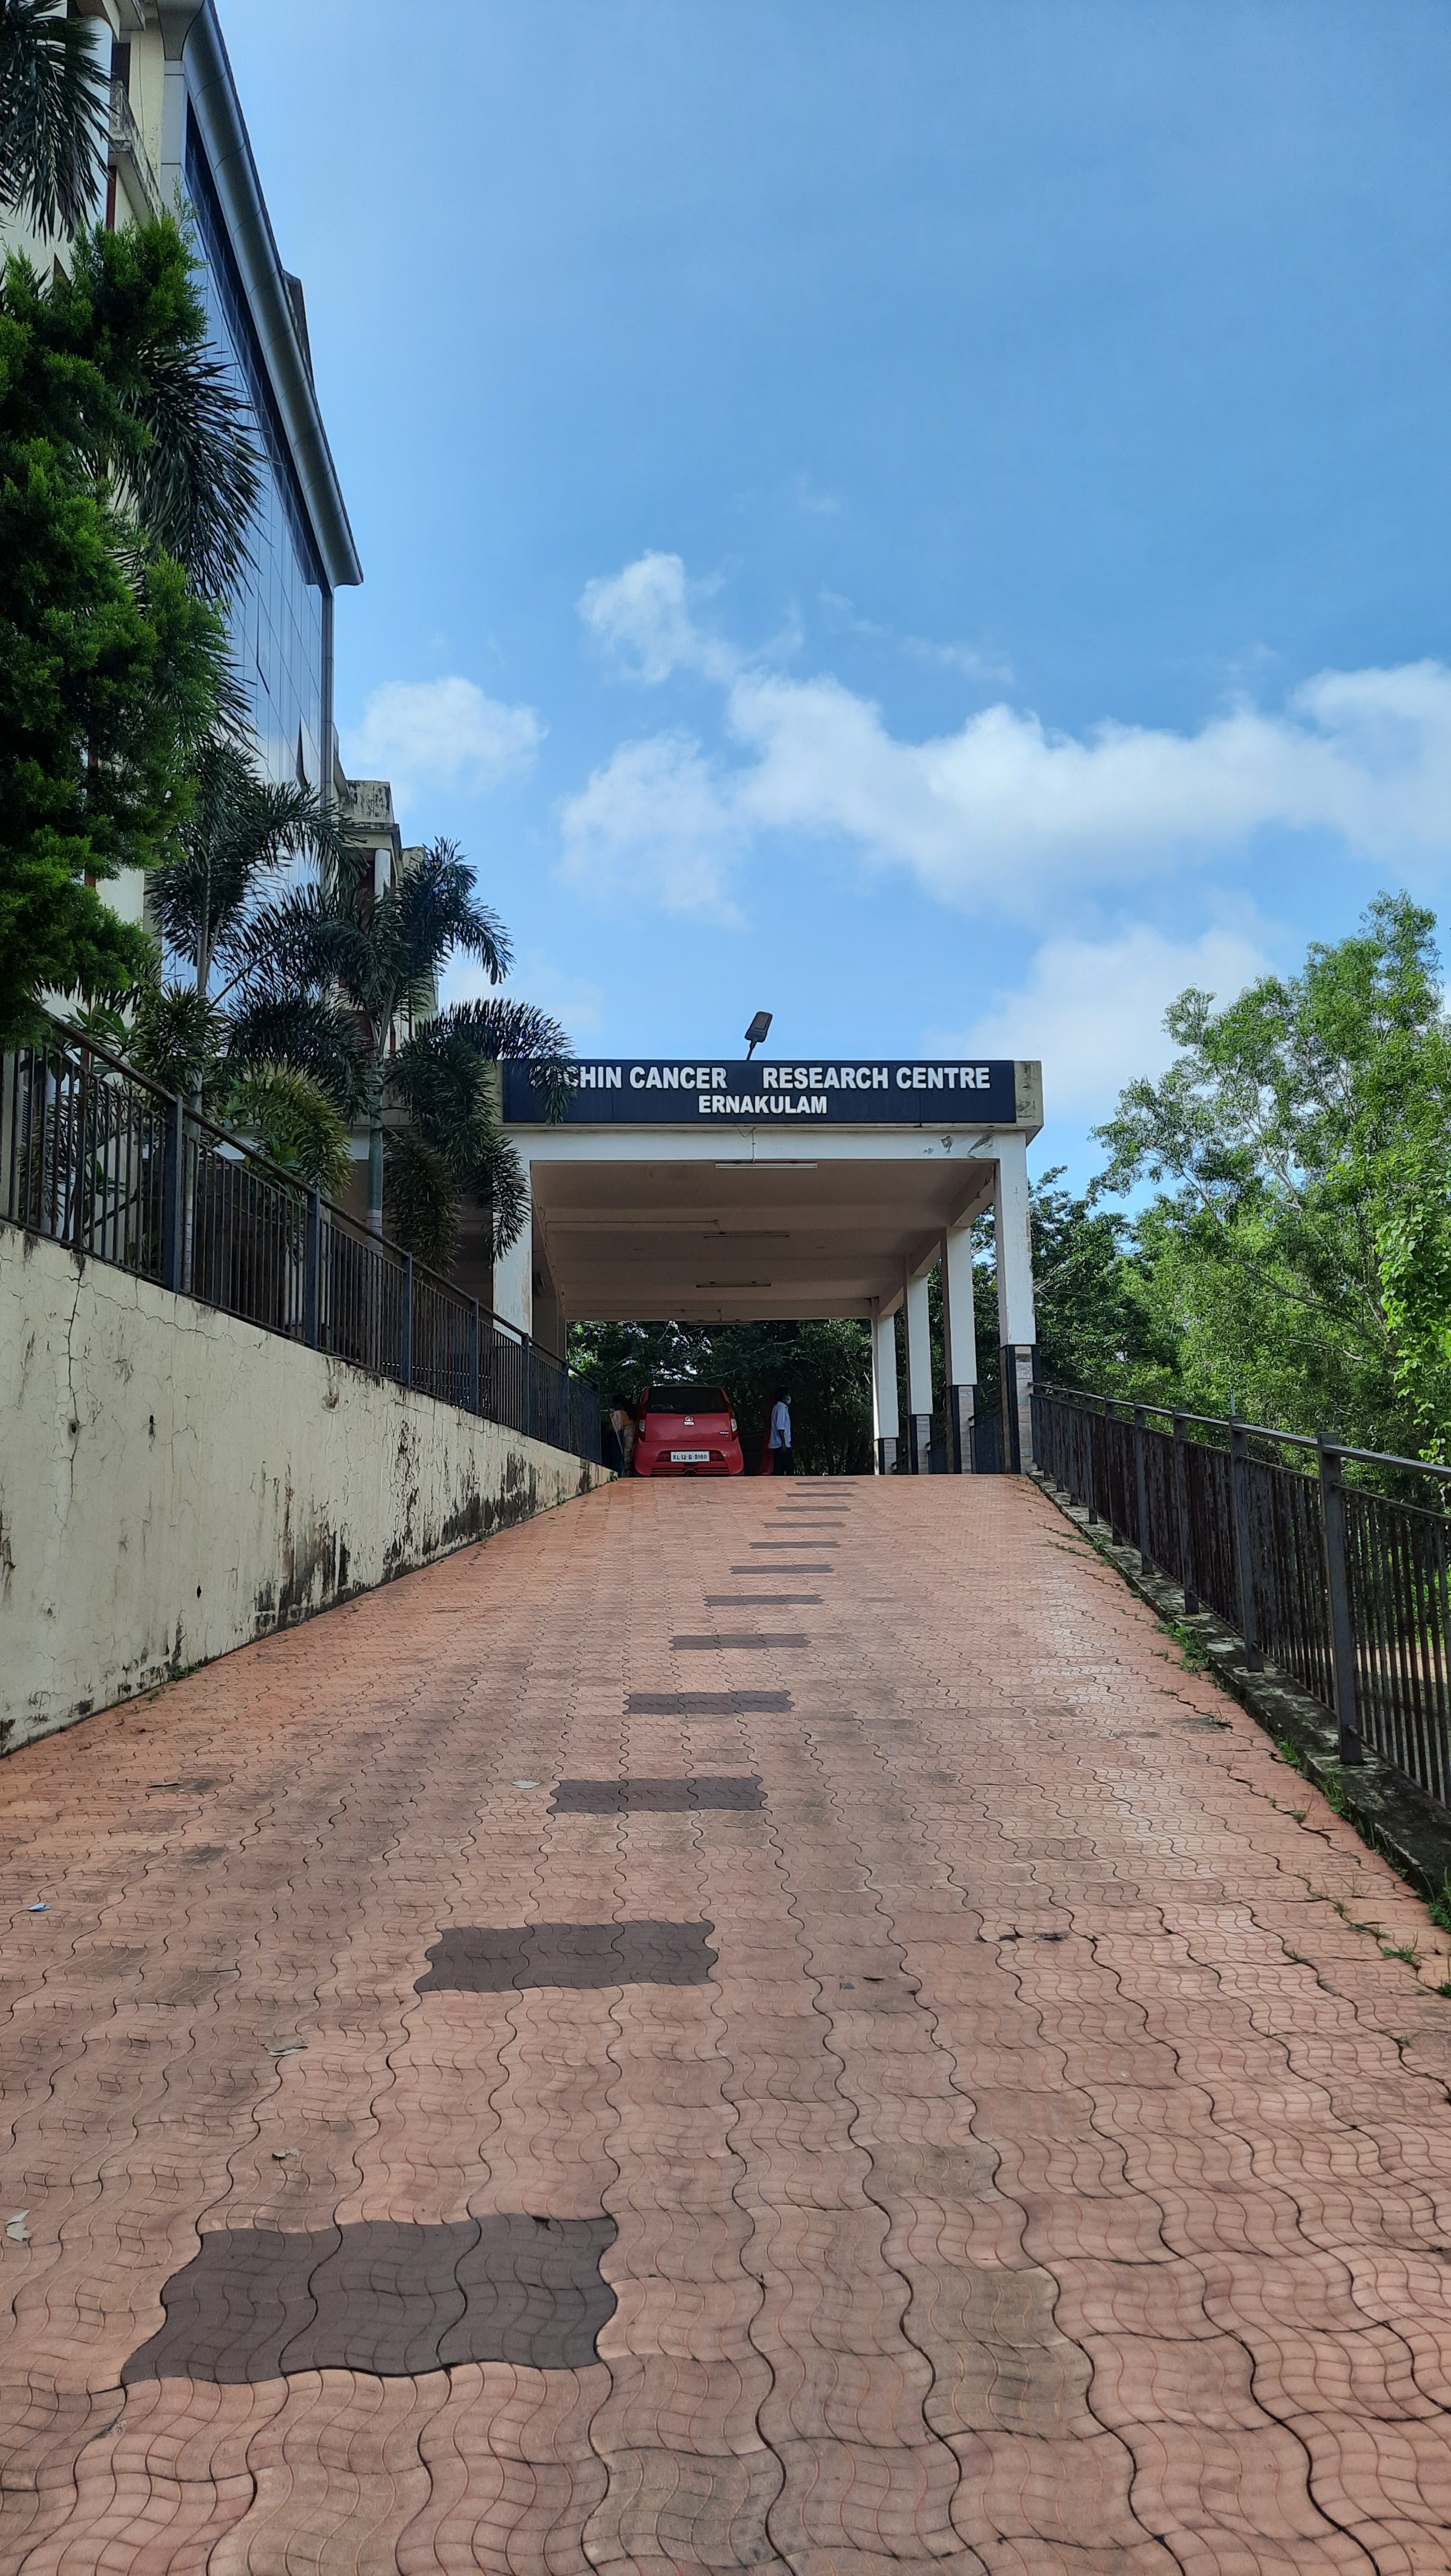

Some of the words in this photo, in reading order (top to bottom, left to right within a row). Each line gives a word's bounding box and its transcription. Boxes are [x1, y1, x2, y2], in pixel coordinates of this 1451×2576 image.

[529, 1066, 622, 1089] CHIN
[630, 1066, 728, 1089] CANCER
[763, 1067, 888, 1089] RESEARCH
[896, 1067, 991, 1089] CENTRE
[699, 1095, 827, 1114] ERNAKULAM
